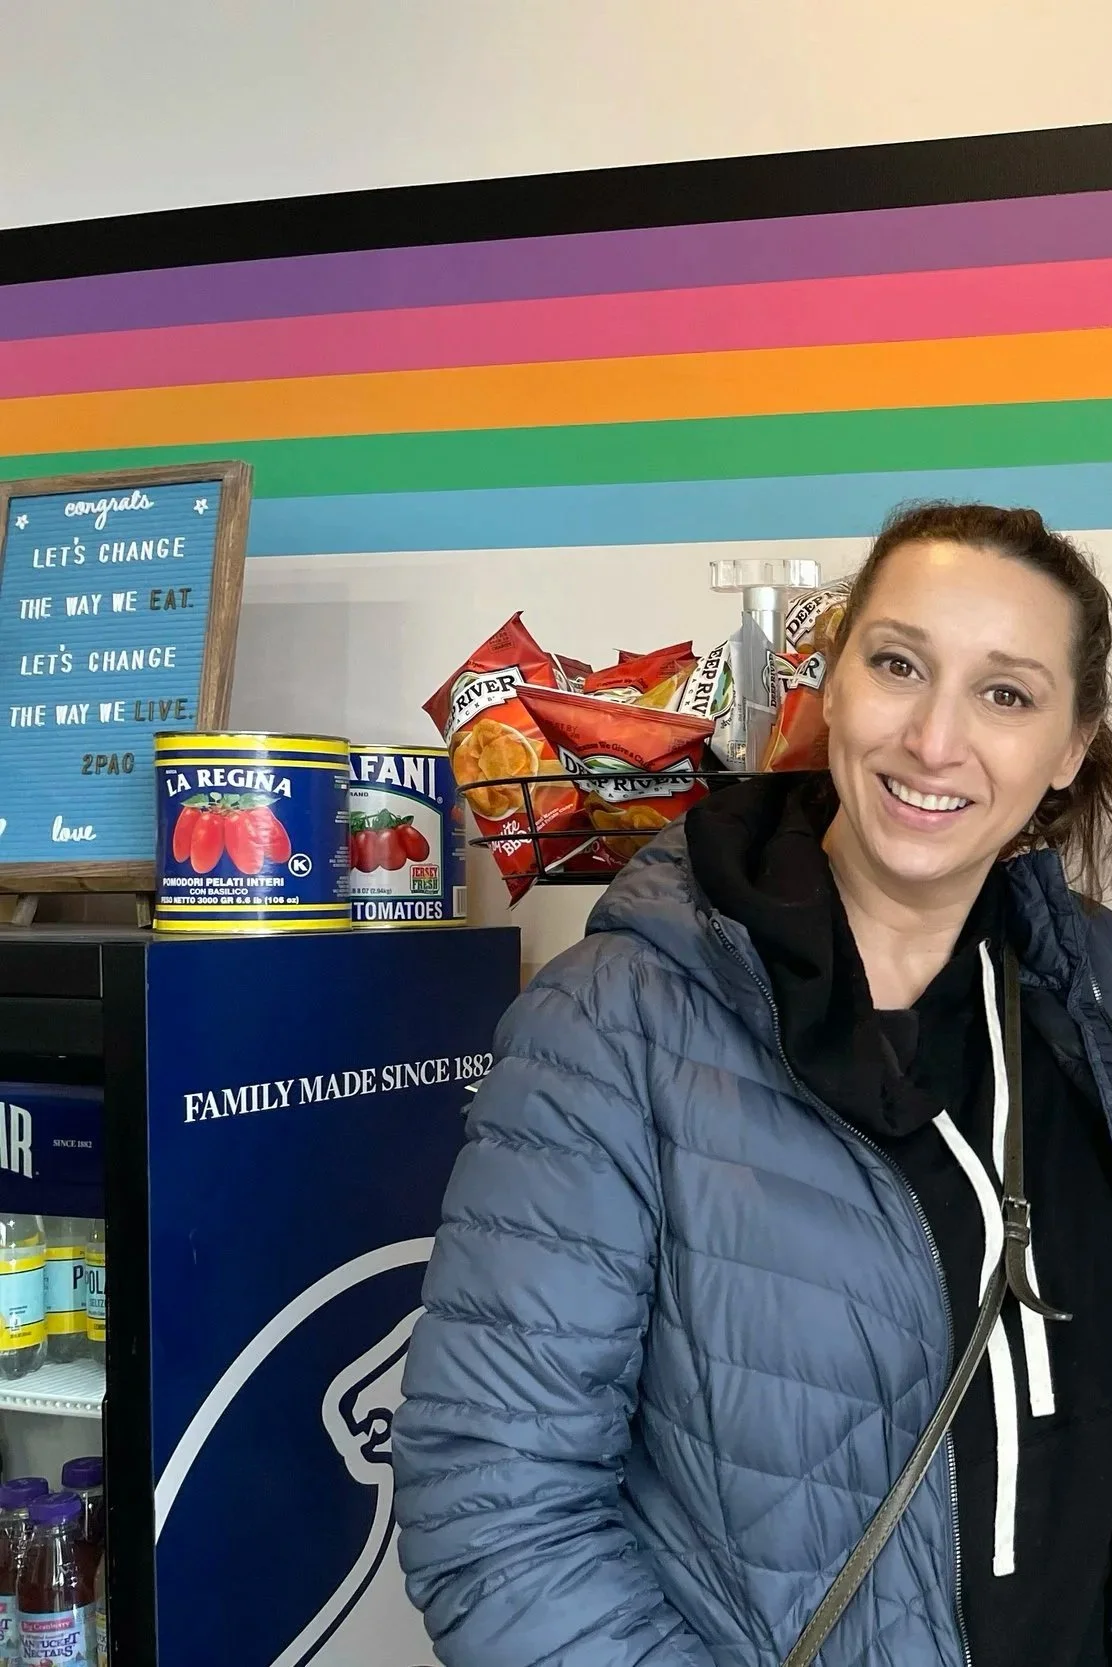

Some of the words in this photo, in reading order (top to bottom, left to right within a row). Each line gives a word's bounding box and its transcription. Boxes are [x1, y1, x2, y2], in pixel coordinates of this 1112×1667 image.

[65, 489, 155, 530] congrats
[32, 537, 86, 569] LET'S
[99, 537, 186, 563] CHANGE
[19, 596, 52, 620] THE
[66, 593, 102, 616] WAY
[112, 590, 138, 613] WE
[149, 587, 194, 611] EAT.
[20, 643, 73, 676] LET'S
[88, 646, 176, 672] CHANGE
[458, 674, 518, 713] RIVER
[9, 704, 46, 728] THE
[55, 703, 89, 726] WAY
[99, 701, 125, 724] WE
[134, 698, 195, 723] LIVE.
[612, 743, 629, 755] Give
[80, 752, 136, 777] 2PAC
[166, 773, 192, 798] LA
[196, 768, 292, 798] REGINA
[51, 815, 97, 843] love
[162, 877, 204, 887] POMODORI
[205, 878, 244, 887] PELATI
[246, 878, 285, 887] INTERI
[412, 867, 438, 877] JERSEY
[412, 879, 438, 890] FRESH
[173, 896, 196, 904] NETTO
[197, 896, 218, 904] 3000
[220, 896, 234, 904] GR
[189, 888, 207, 896] CON
[207, 888, 249, 896] BASILICO
[353, 901, 444, 921] TOMATOES
[183, 1079, 296, 1123] FAMILY
[299, 1068, 377, 1105] MADE
[381, 1057, 450, 1091] SINCE
[454, 1052, 495, 1079] 1882
[53, 1139, 76, 1148] SINCE
[77, 1140, 93, 1148] 1882
